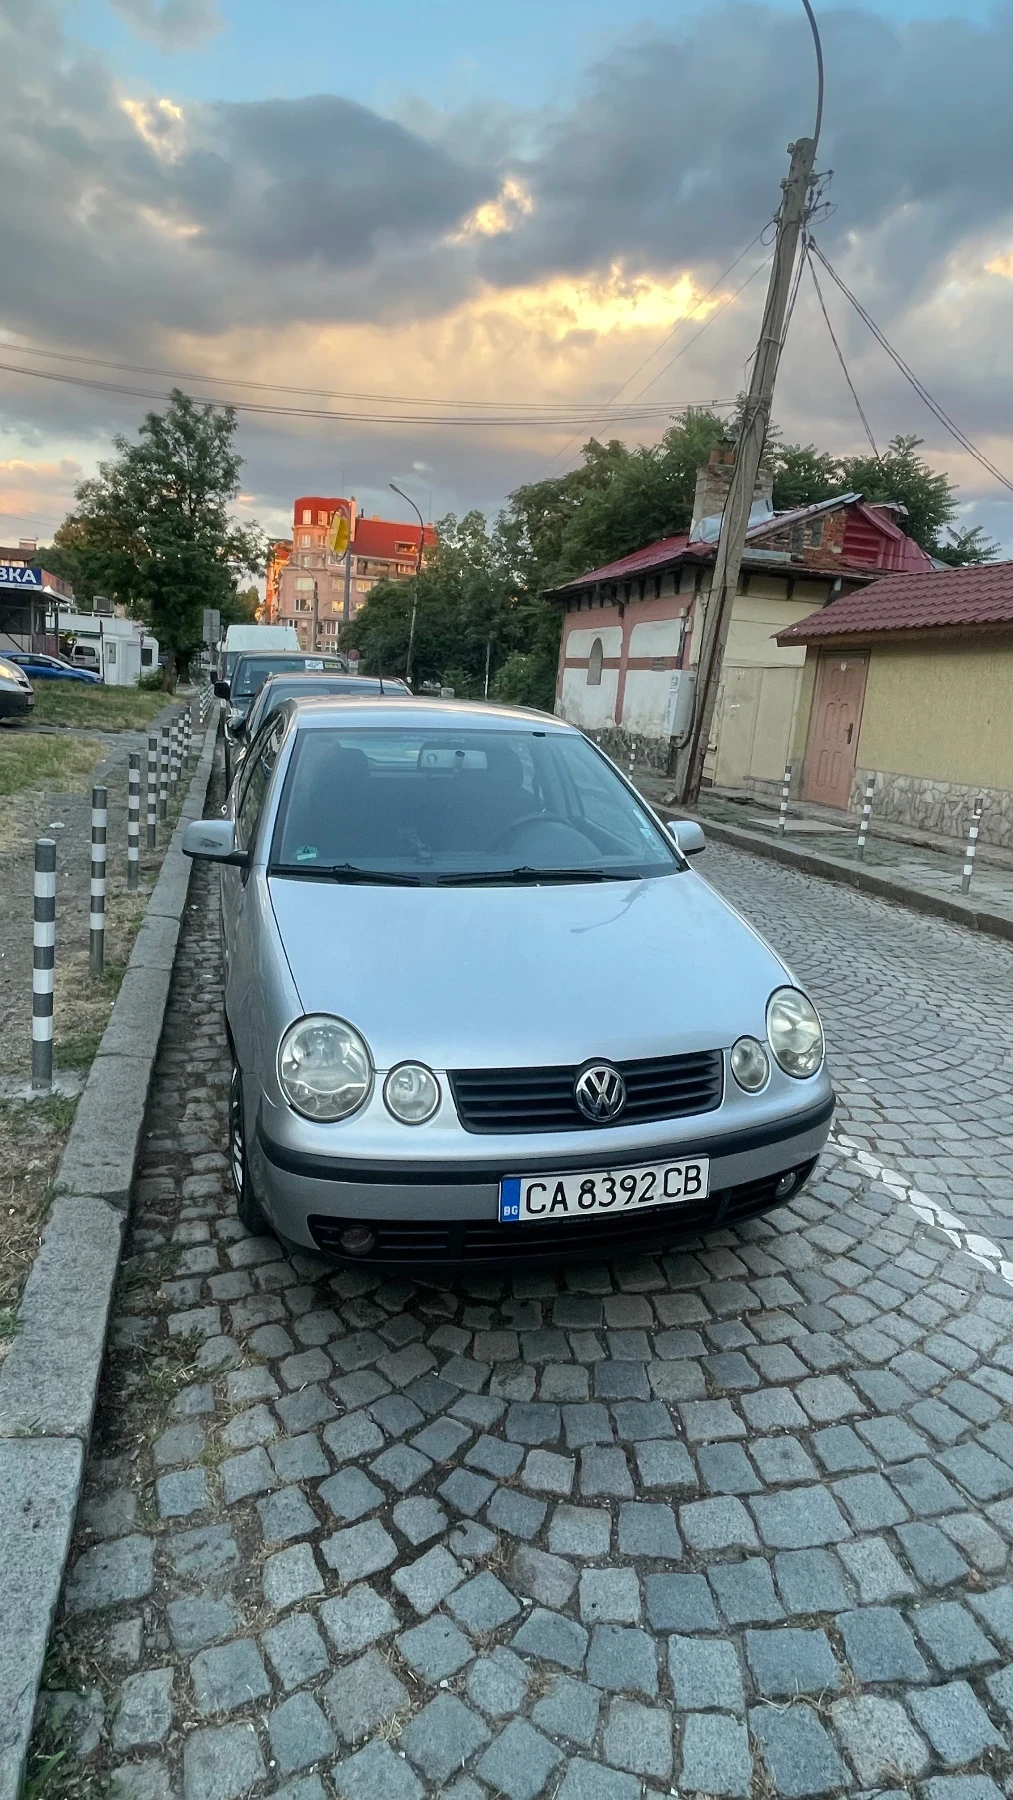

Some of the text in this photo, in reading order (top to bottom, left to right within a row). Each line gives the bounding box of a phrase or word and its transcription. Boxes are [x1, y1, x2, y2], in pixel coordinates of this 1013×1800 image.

[577, 1066, 624, 1120] VW
[503, 1205, 518, 1216] BG
[526, 1165, 701, 1214] CA 8392 CB
